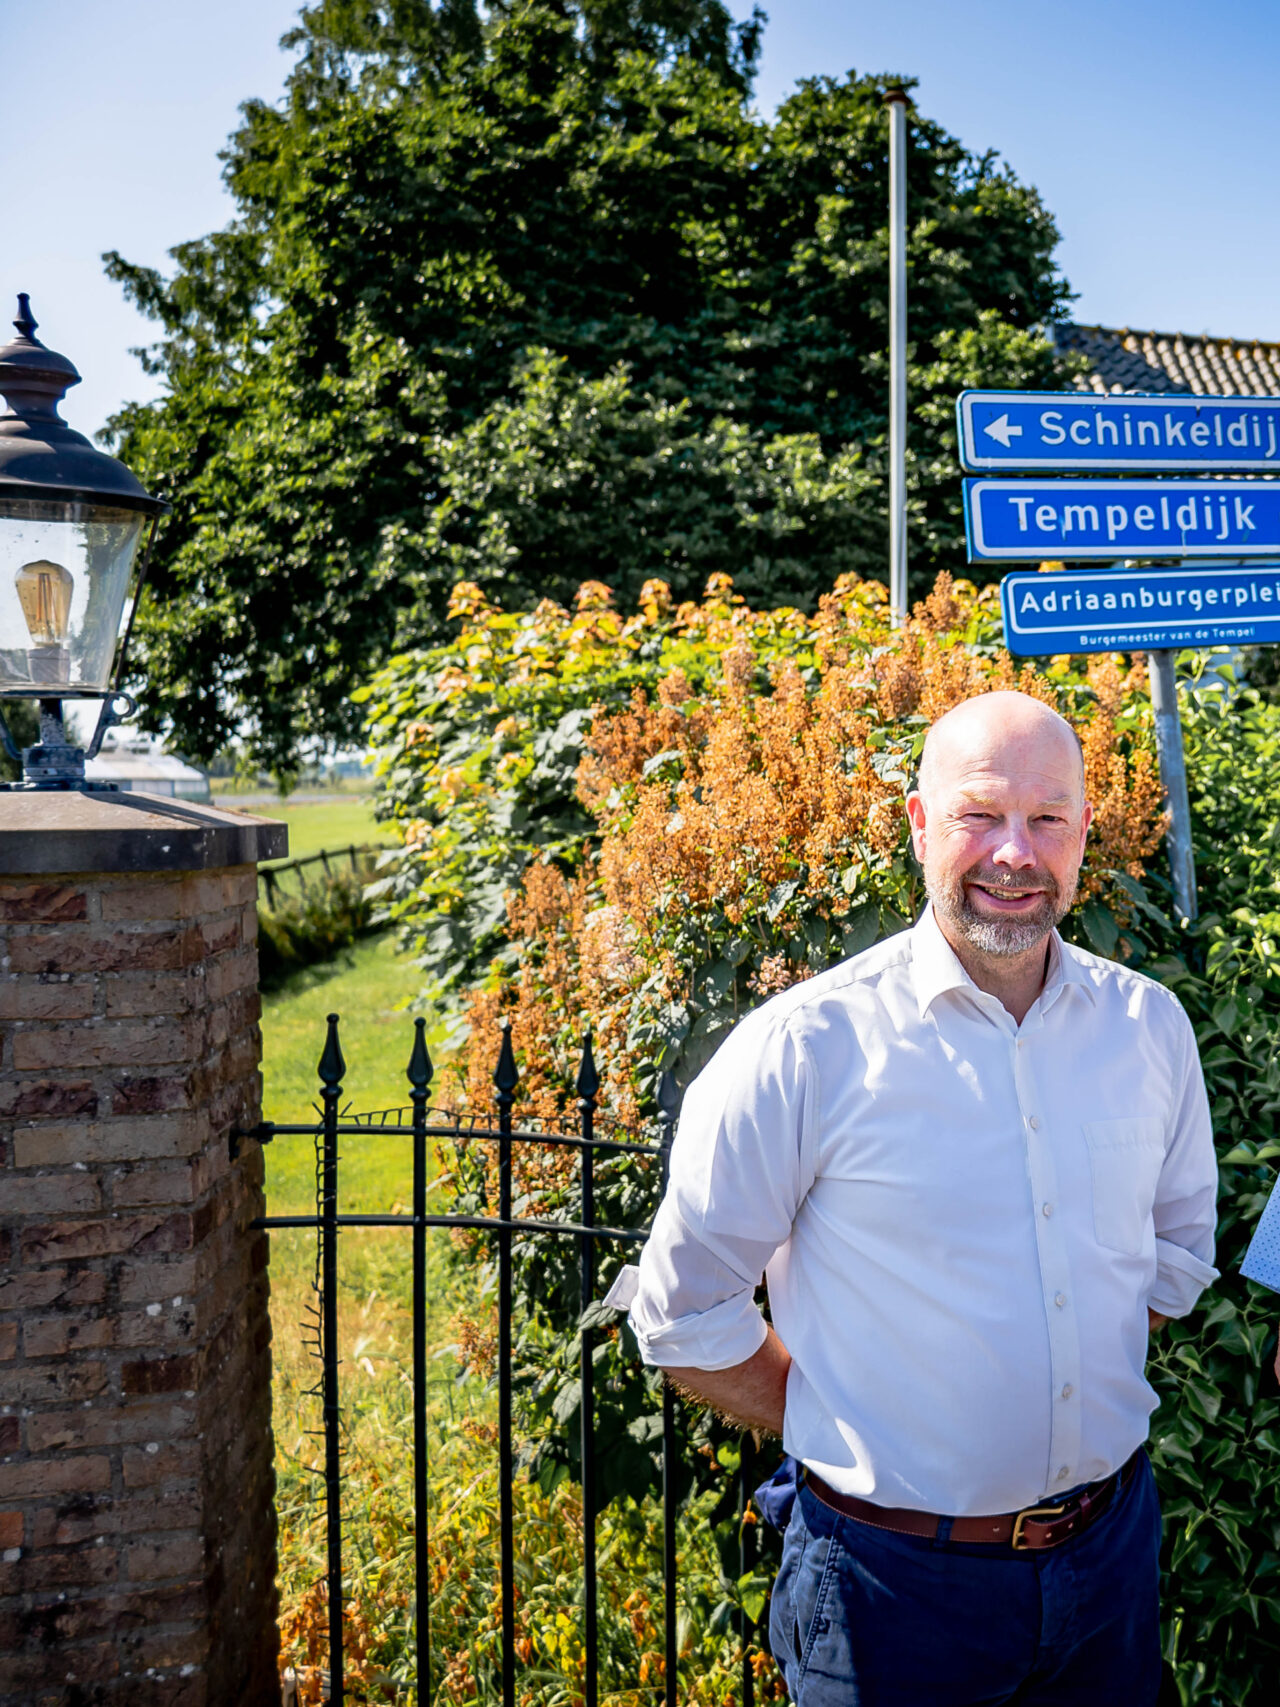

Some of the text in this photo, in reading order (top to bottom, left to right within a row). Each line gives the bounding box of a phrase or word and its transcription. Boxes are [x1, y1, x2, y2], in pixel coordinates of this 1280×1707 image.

[1008, 496, 1256, 541] Tempeldijk
[1080, 627, 1255, 646] Burgemeester van de Tempel
